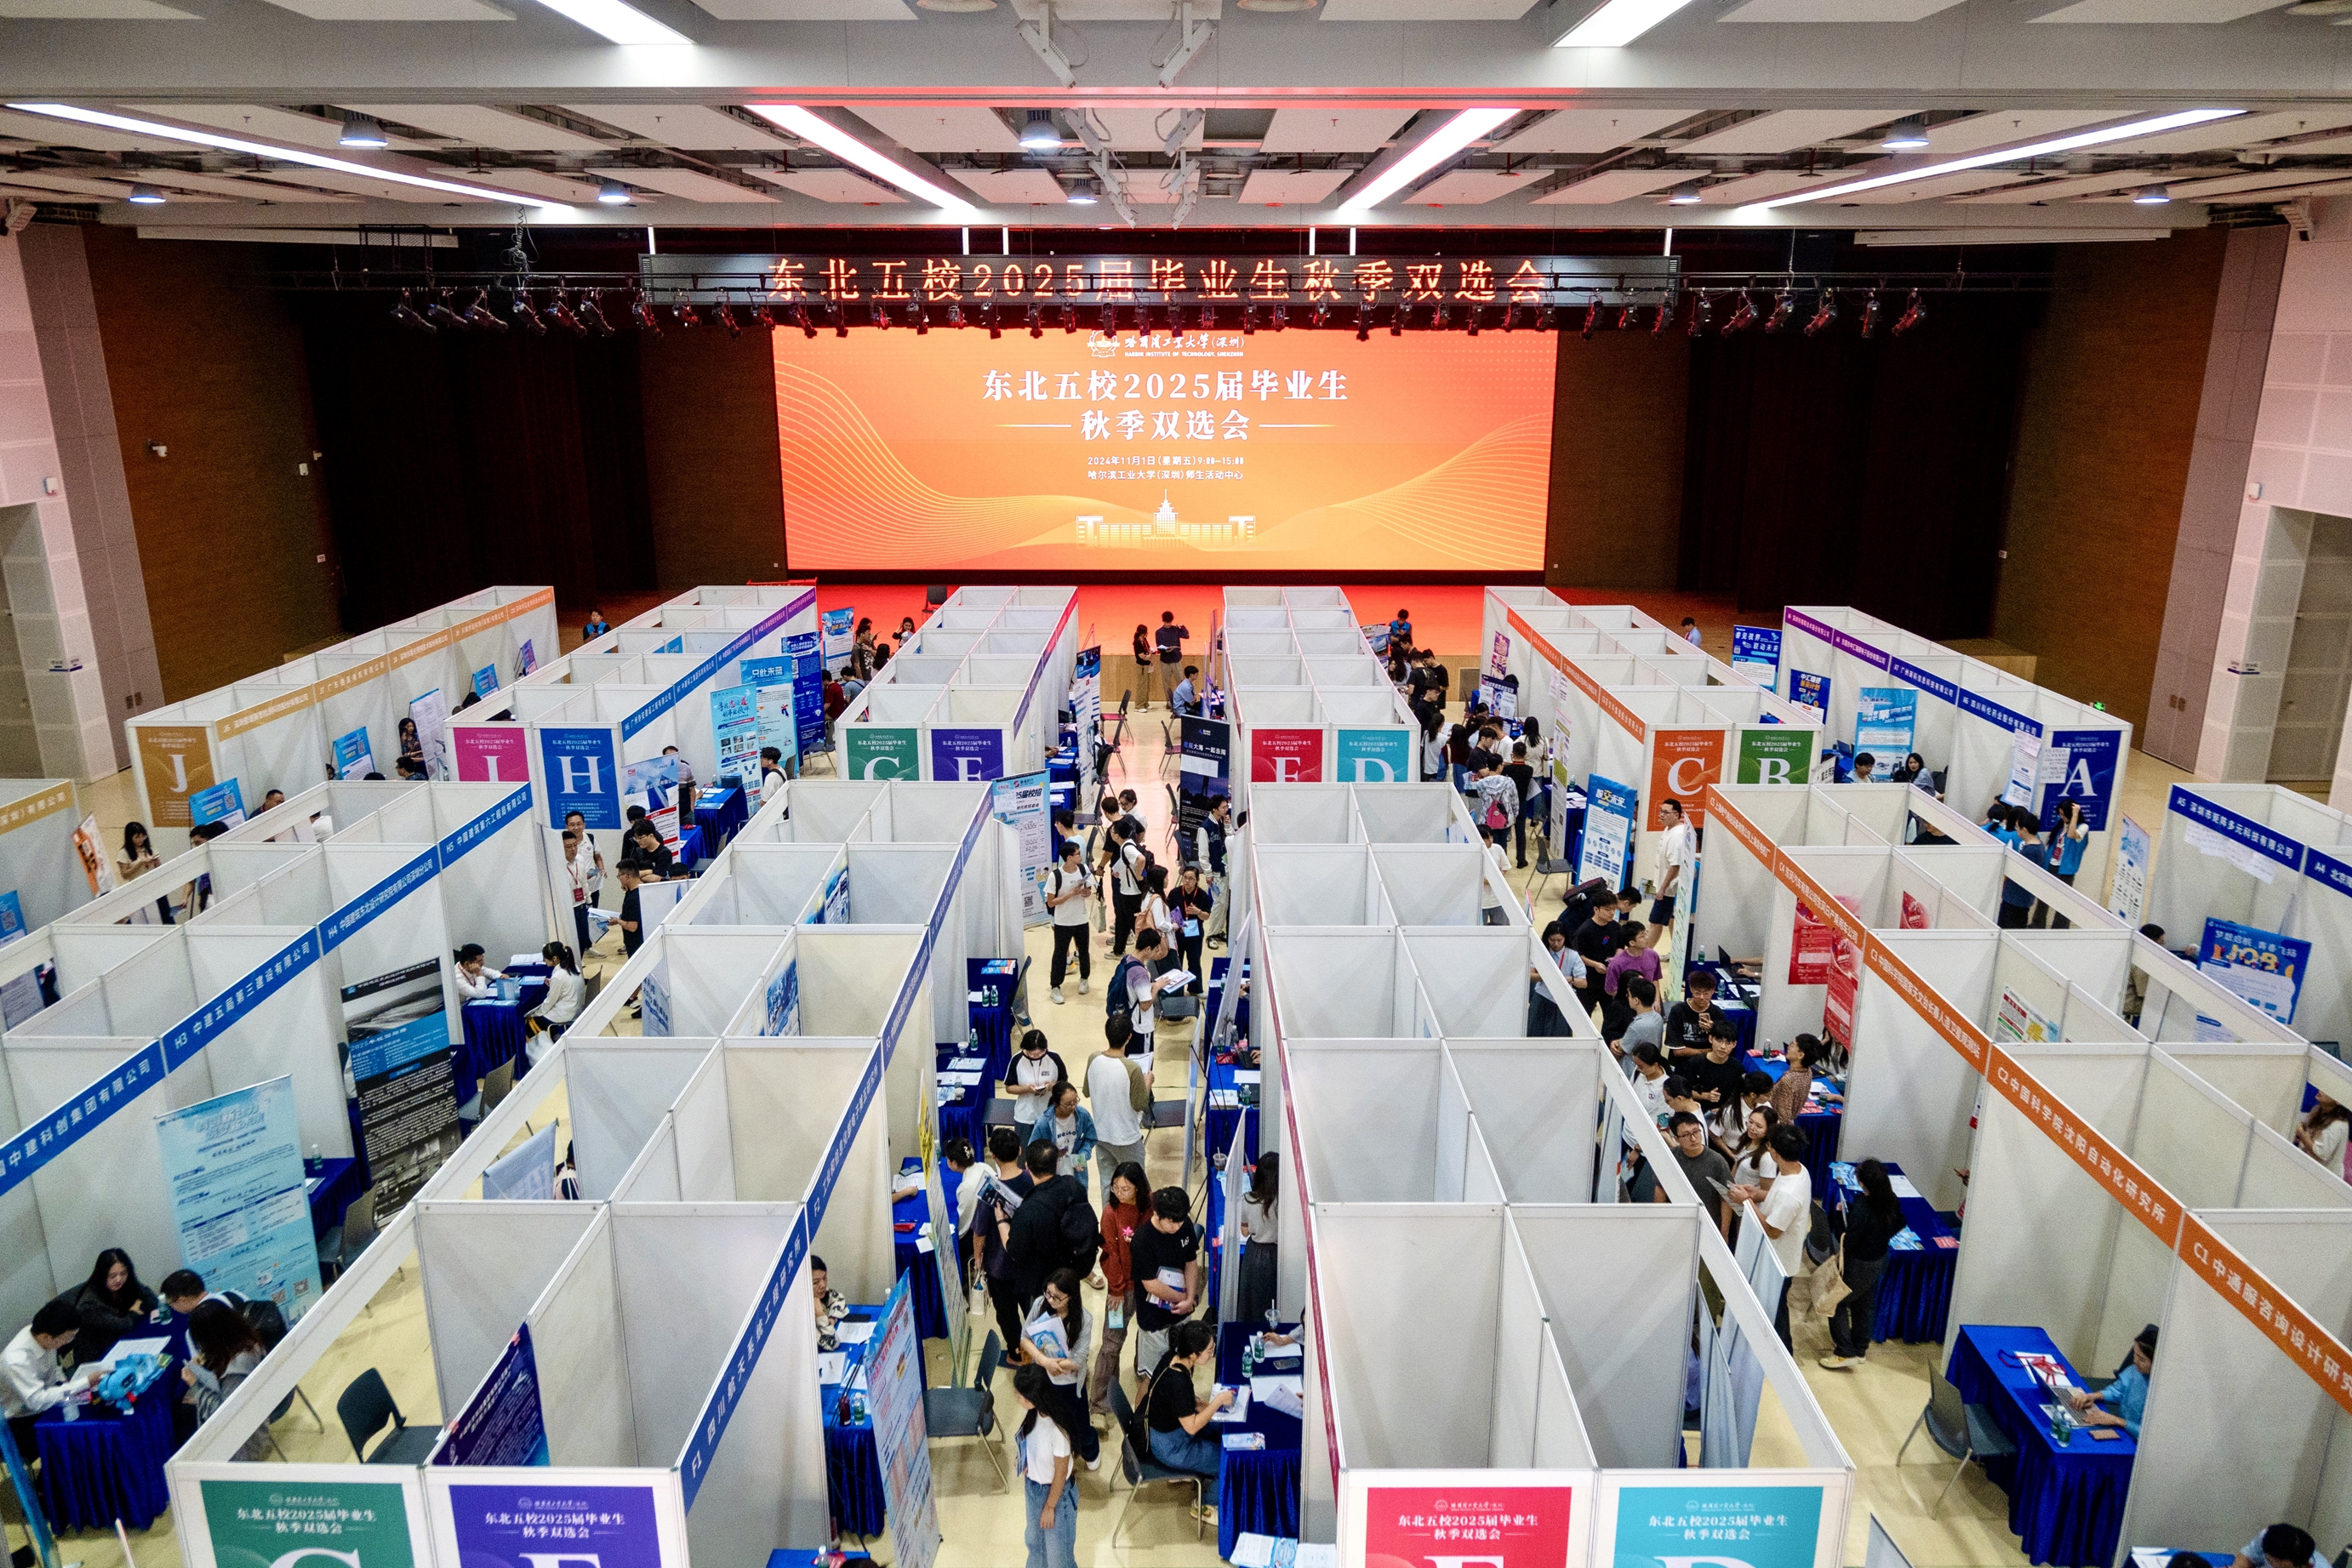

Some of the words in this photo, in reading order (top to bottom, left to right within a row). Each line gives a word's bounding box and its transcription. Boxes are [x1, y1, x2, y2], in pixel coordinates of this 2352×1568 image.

[768, 258, 1546, 302] 东北五校2025届毕业生秋季双选会
[983, 369, 1349, 402] 东北五校2025届毕业生
[1080, 409, 1250, 441] 秋季双选会
[168, 754, 188, 793] J
[556, 755, 605, 794] H
[1668, 757, 1705, 795] C
[2058, 758, 2098, 797] A
[446, 839, 454, 855] H5
[455, 790, 527, 848] 中国建筑第六工程局有限公司
[2176, 794, 2186, 808] A5
[2188, 800, 2294, 860] 深圳市矩阵多元科技有限公司
[1778, 859, 1784, 875] C4
[2314, 859, 2325, 875] A4
[327, 922, 337, 941] H4
[339, 856, 433, 936] 中国建筑东北设计研究院有限公司深圳分公司
[1870, 946, 1877, 964] C3
[174, 1029, 187, 1052] H3
[192, 939, 310, 1039] 中建五局第三建设有限公司
[1996, 1063, 2009, 1086] C2
[2008, 1073, 2166, 1227] 中国科学院沈阳自动化研究所
[2192, 1236, 2209, 1269] C1
[690, 1450, 703, 1479] F1
[705, 1234, 802, 1444] 四川航天系统工程研究所
[275, 1522, 343, 1535] 秋季双选会
[484, 1510, 625, 1526] 东北五校2025届毕业生
[522, 1526, 590, 1540] 秋季双选会
[1398, 1514, 1539, 1527] 东北五校2025届毕业生
[1434, 1528, 1501, 1541] 秋季双选会
[1648, 1514, 1790, 1527] 东北五校2025届毕业生
[1684, 1528, 1751, 1541] 秋季双选会
